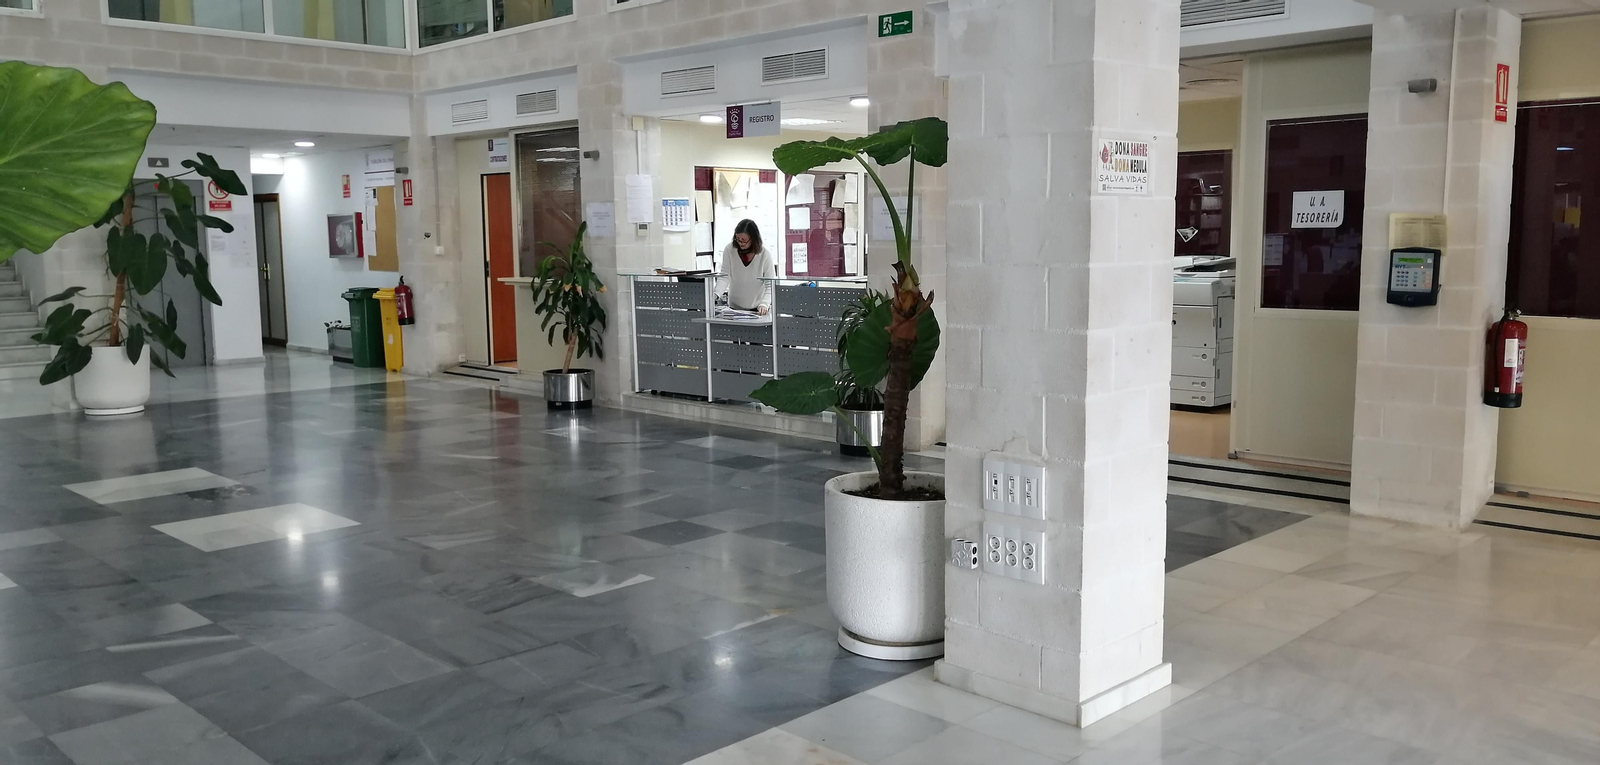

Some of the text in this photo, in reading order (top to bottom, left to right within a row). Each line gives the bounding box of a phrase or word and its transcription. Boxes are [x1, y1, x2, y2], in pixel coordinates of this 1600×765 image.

[749, 114, 775, 123] REGISTRO
[1114, 141, 1148, 157] DONA SANGRE
[1114, 158, 1130, 173] DONA
[1098, 174, 1147, 184] SALVA VIDAS
[1296, 209, 1339, 223] TESORERÍA
